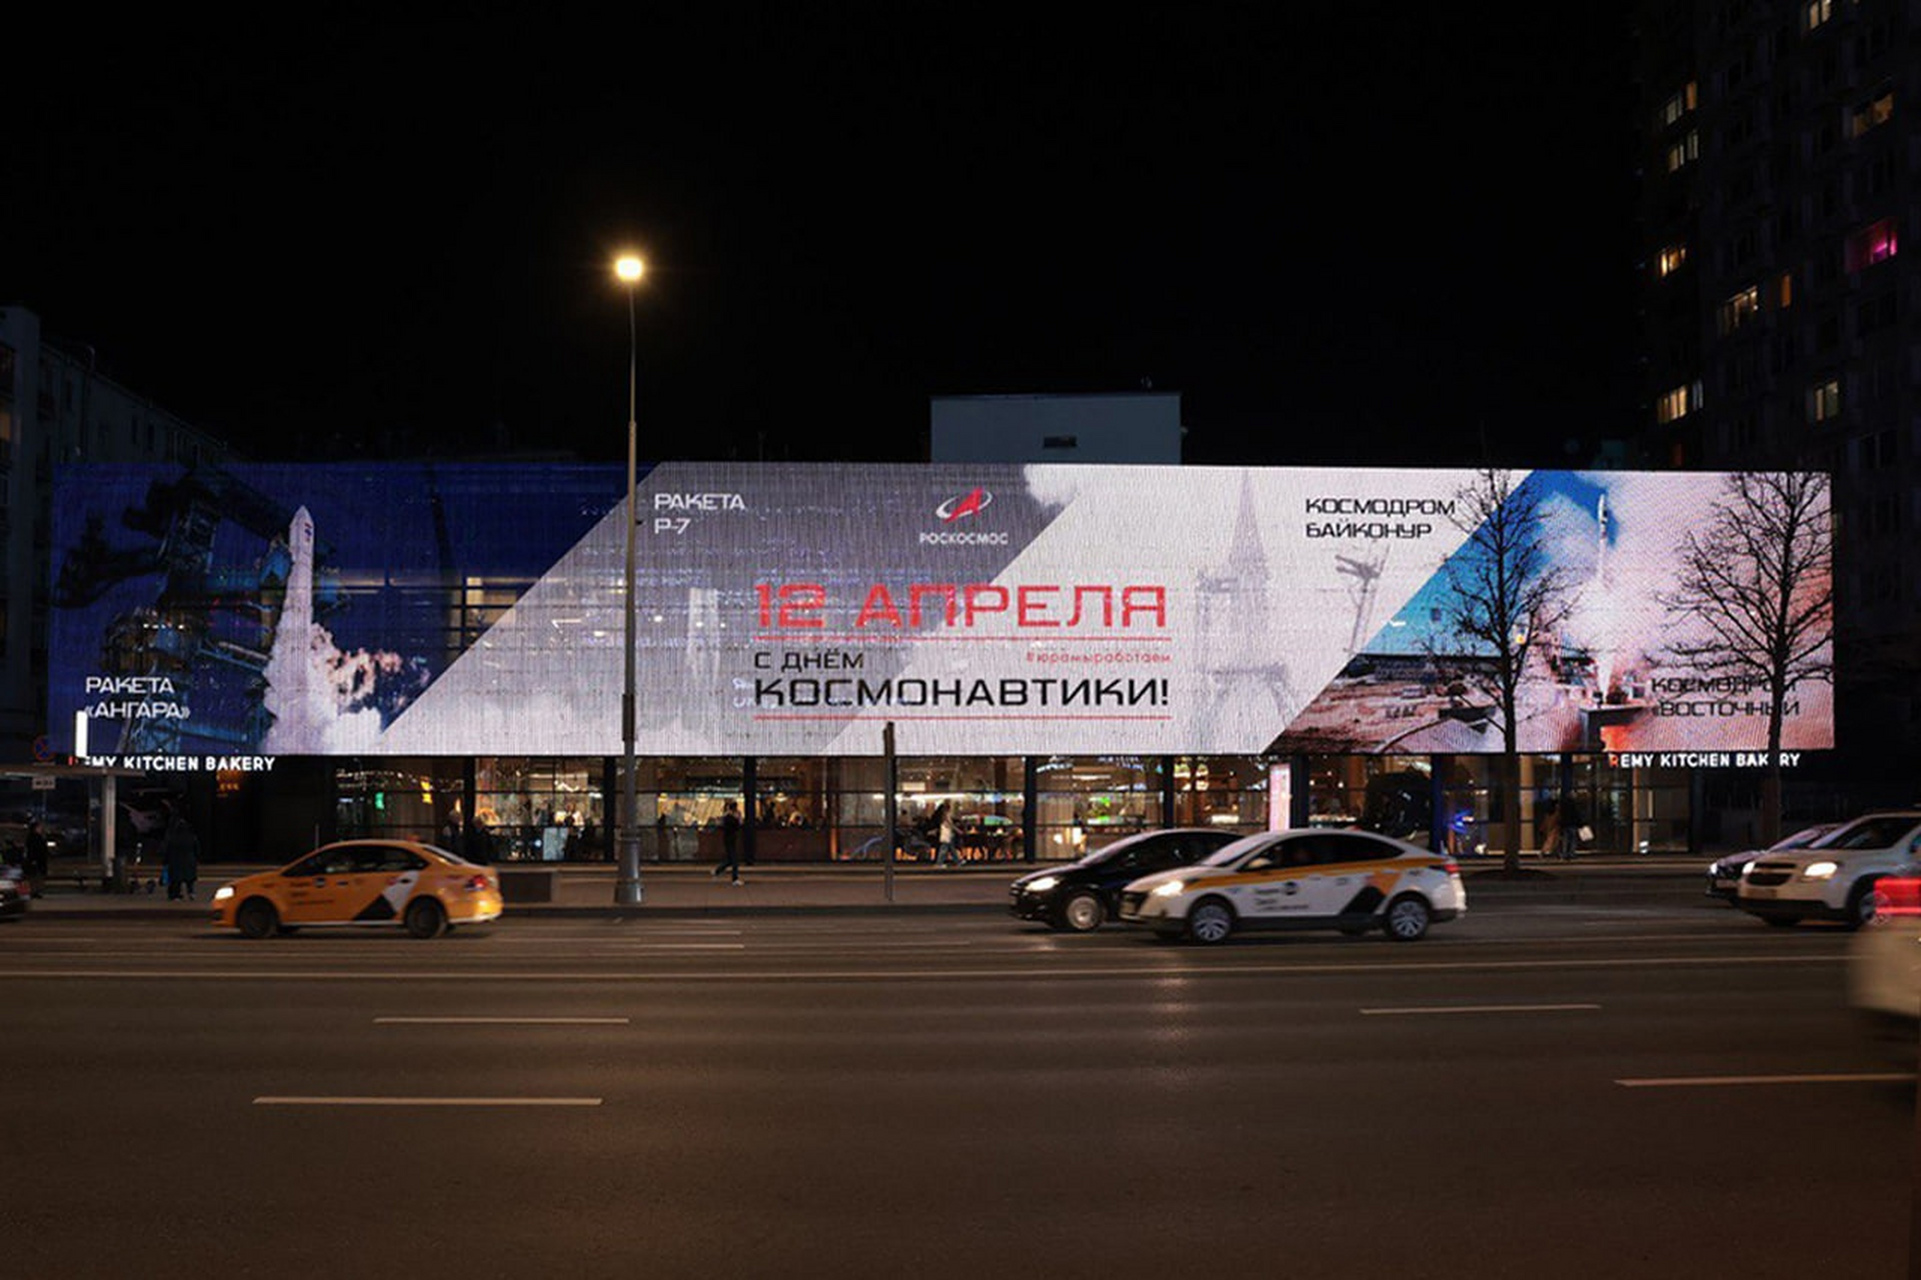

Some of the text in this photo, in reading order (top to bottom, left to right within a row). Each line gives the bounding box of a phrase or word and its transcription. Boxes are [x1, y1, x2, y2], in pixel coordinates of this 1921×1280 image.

[654, 493, 745, 510] РАКЕТА
[1305, 499, 1455, 517] КОСМОДРОМ
[654, 518, 691, 534] Р-7
[1305, 518, 1432, 538] БАЙКОНУР
[919, 532, 1009, 545] РОСКОСМОС
[755, 583, 1166, 627] 12 АПРЕЛЯ
[754, 648, 864, 673] С ДНЁМ
[85, 677, 175, 694] РАКЕТА
[754, 678, 1169, 706] КОСМОНАВТИКИ!
[1651, 677, 1797, 695] КОСМОДРО
[84, 701, 191, 719] «АНГАРА»
[124, 756, 199, 771] KITCHEN
[205, 756, 275, 771] BAKERY
[1609, 753, 1800, 768] REMY KITCHEN BAKRY
